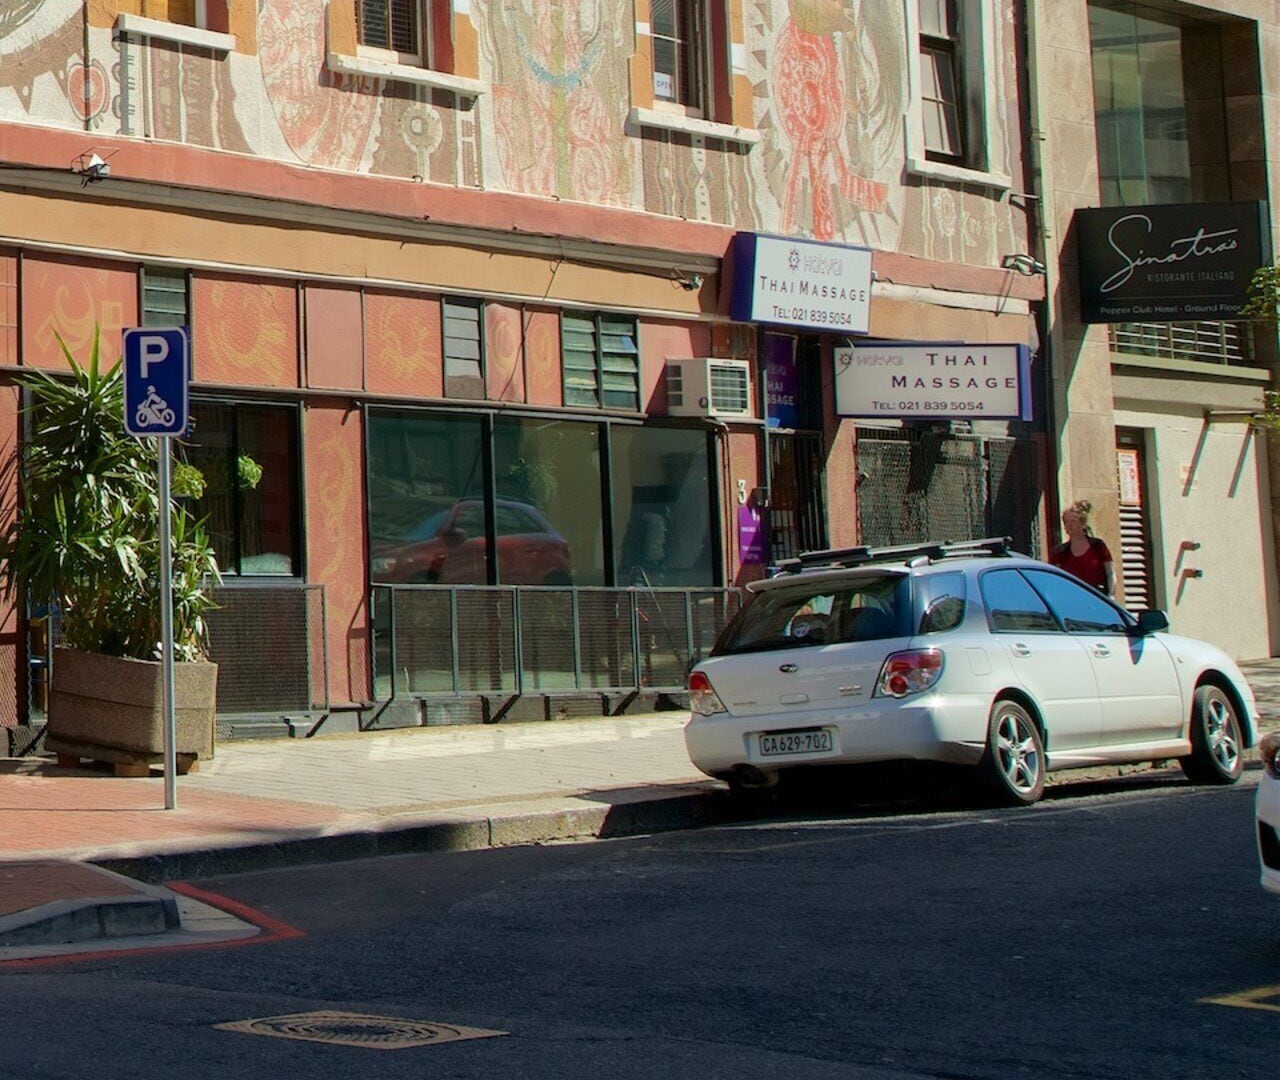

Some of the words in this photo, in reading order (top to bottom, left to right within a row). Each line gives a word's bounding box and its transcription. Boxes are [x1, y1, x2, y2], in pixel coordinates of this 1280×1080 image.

[1100, 214, 1239, 293] Sinatra's
[1147, 271, 1196, 283] RISTORANTE
[1198, 270, 1235, 281] ITALIANO
[760, 275, 794, 294] THAI
[800, 280, 866, 302] MASSAGE
[791, 307, 808, 320] 021
[829, 311, 852, 325] 5054
[1100, 306, 1131, 316] Pepper
[1132, 304, 1153, 314] Club
[1154, 304, 1178, 313] Hotel
[1184, 303, 1218, 314] Ground
[140, 335, 169, 379] P
[926, 353, 988, 367] THAI
[891, 375, 1017, 389] MASSAGE
[898, 402, 920, 411] 021
[923, 402, 948, 411] 839
[950, 402, 985, 411] 5054
